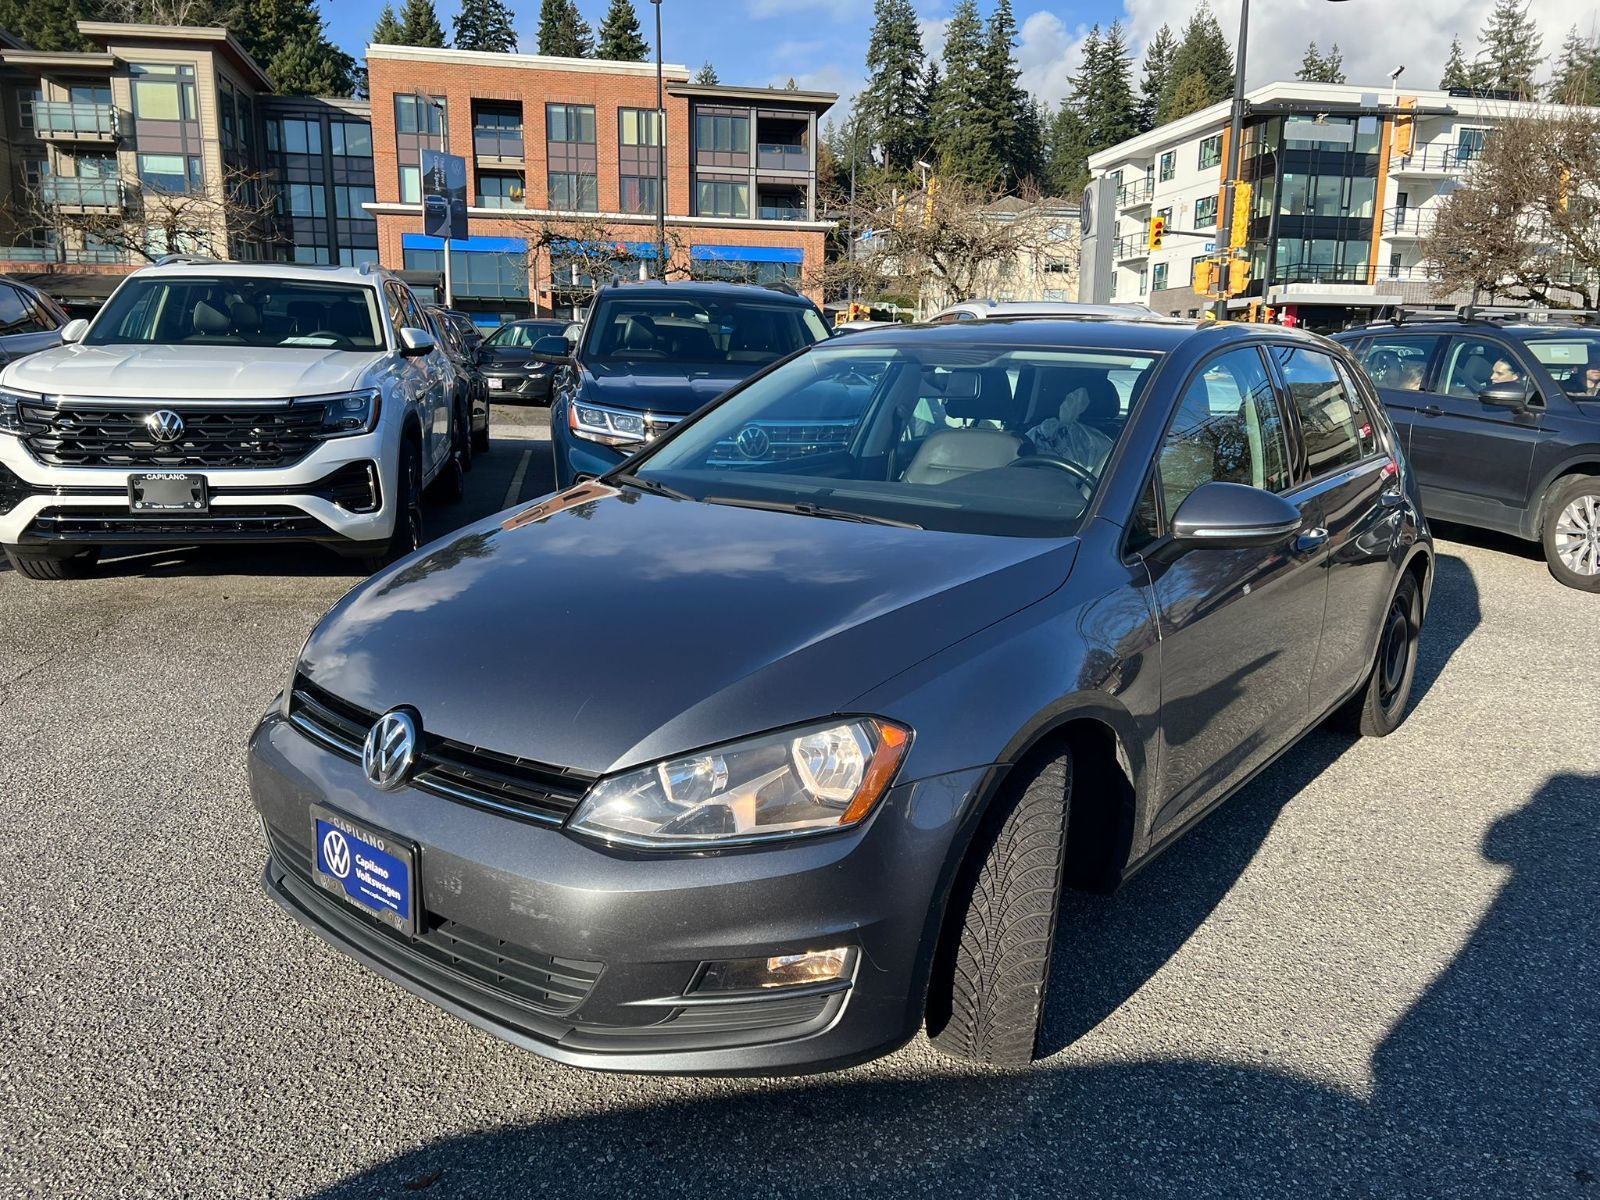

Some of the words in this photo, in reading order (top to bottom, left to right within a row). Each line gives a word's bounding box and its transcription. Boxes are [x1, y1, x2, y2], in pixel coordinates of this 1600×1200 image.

[146, 473, 185, 481] CAPILANO
[333, 817, 385, 852] CAPILANO
[355, 853, 389, 880] Capilano
[355, 868, 401, 901] Volkswagen
